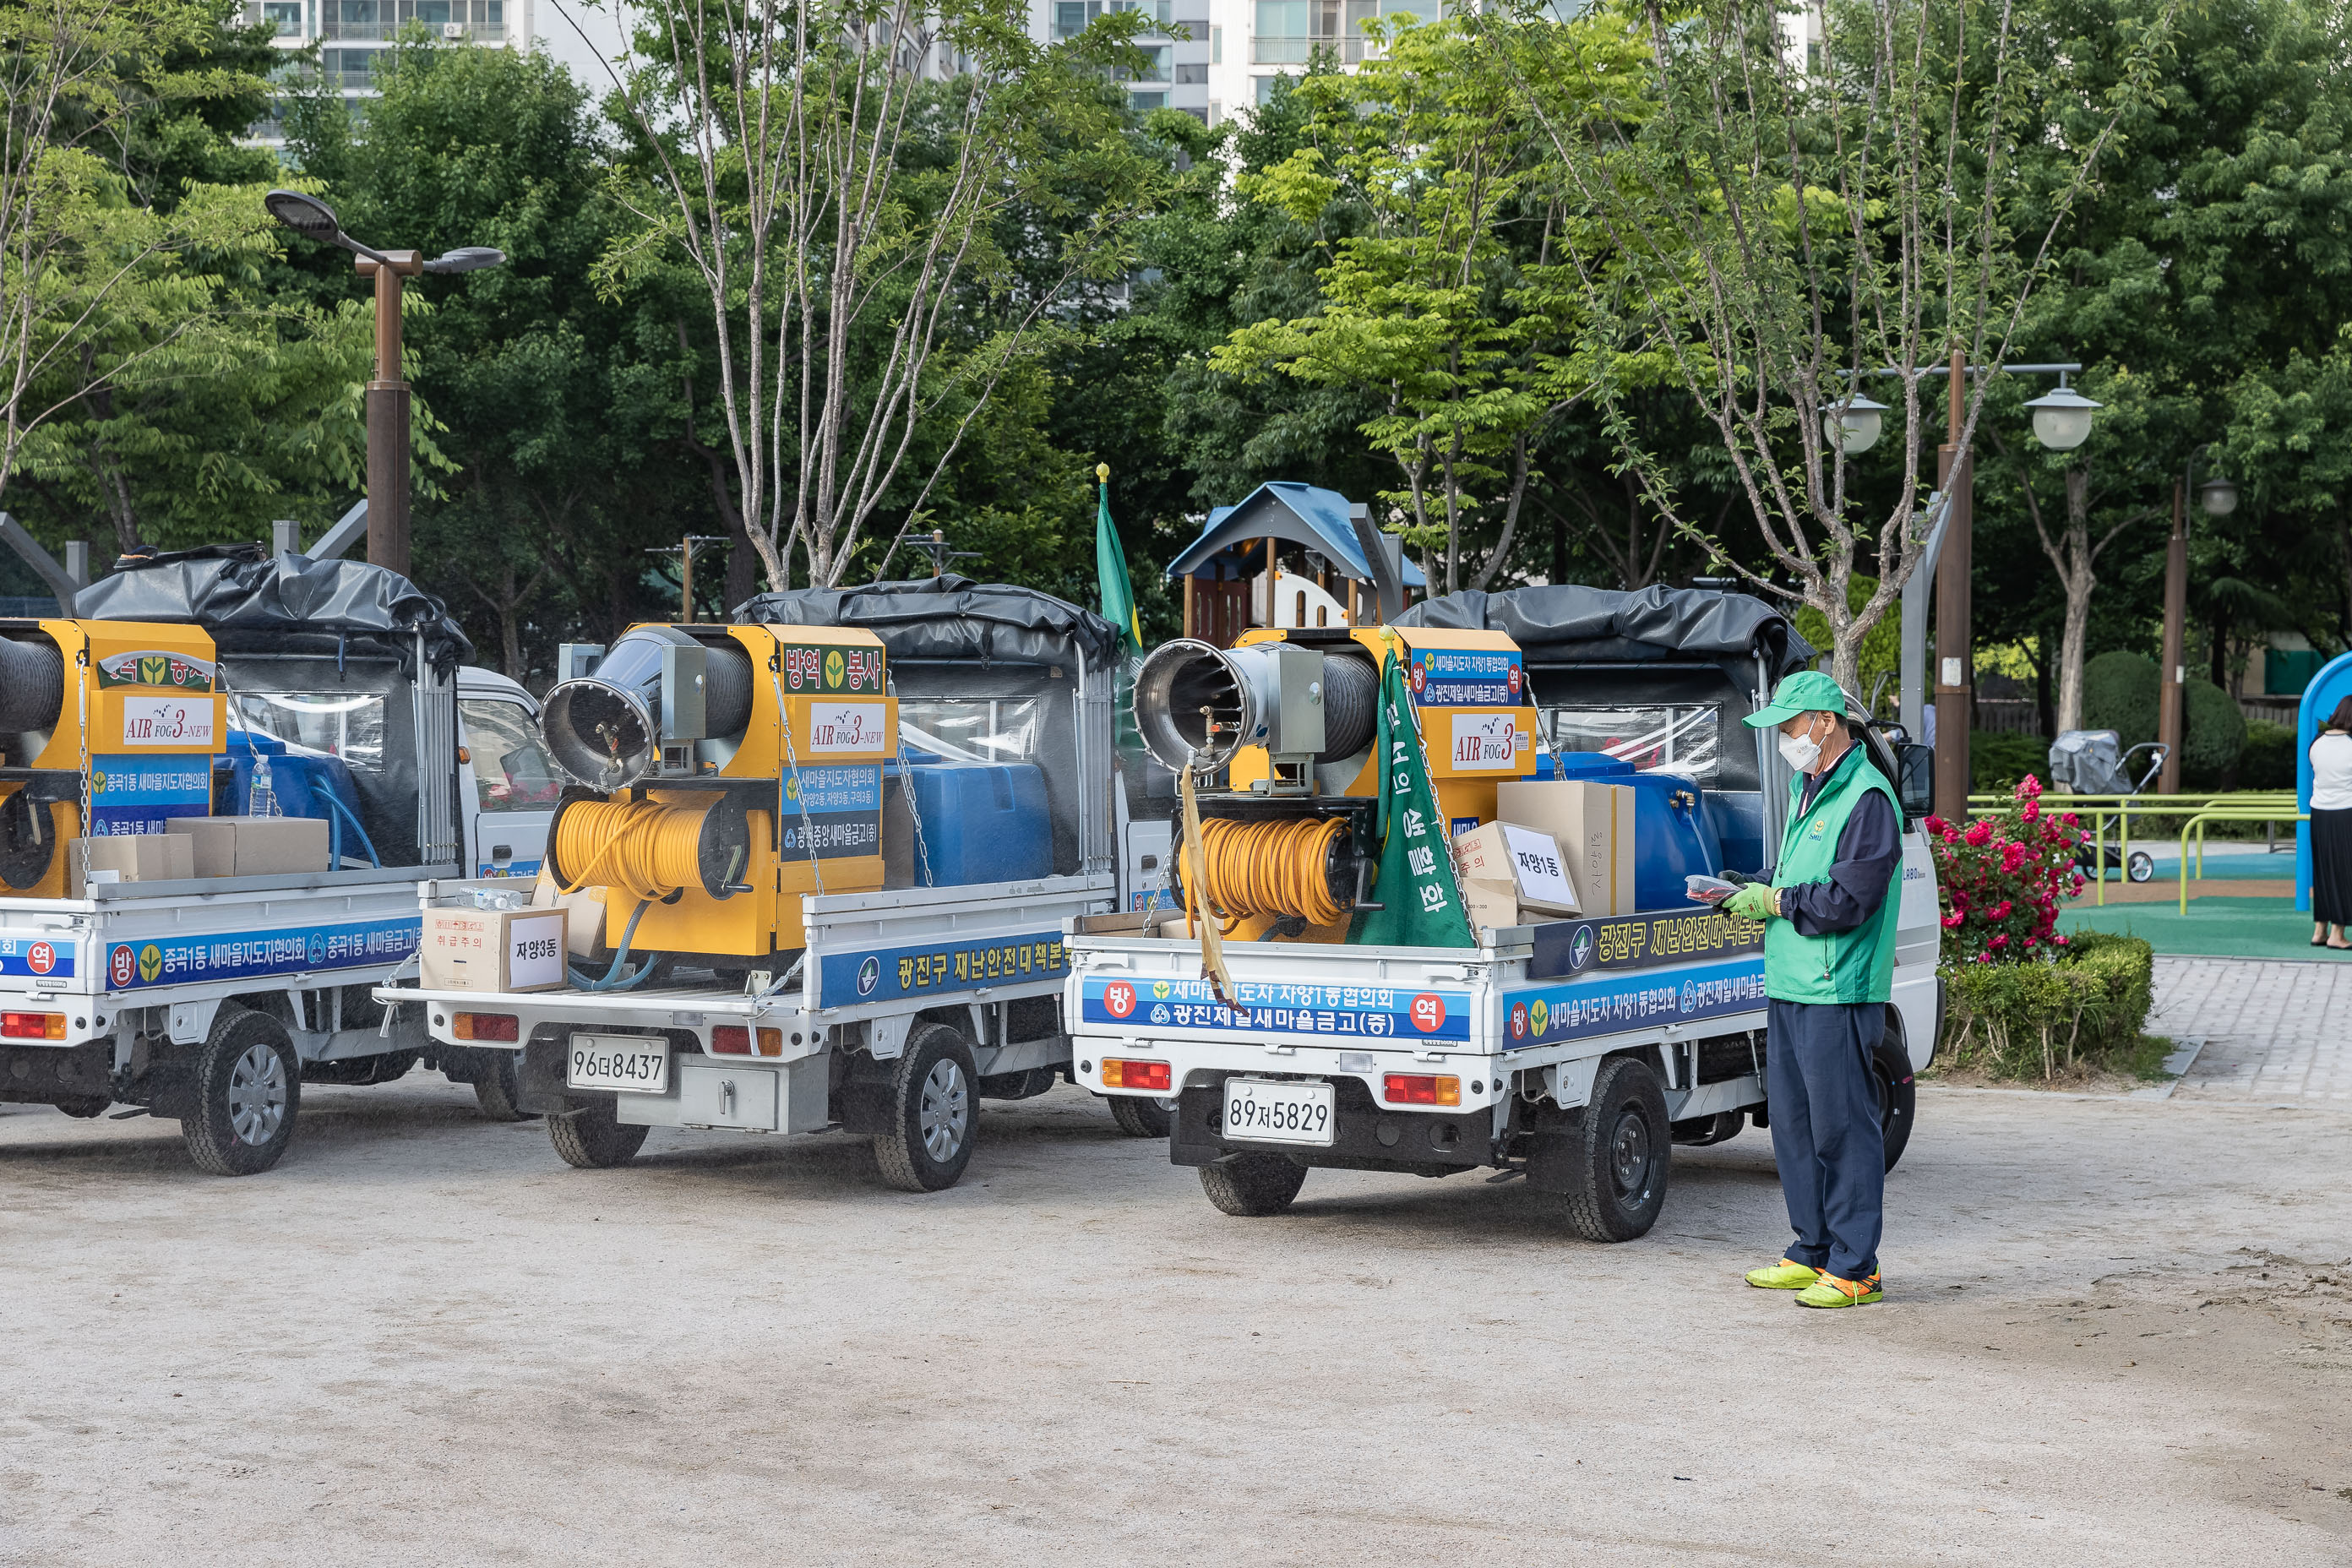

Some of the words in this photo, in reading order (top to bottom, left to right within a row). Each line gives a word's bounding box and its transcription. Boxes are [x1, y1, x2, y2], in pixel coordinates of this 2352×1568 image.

[786, 648, 821, 689] 방역
[847, 650, 881, 690] 봉사
[1435, 655, 1471, 672] 새마을지도자
[1413, 667, 1425, 691] 방
[1510, 669, 1520, 691] 역
[125, 718, 153, 738] AIR
[154, 725, 172, 738] FOG
[811, 725, 835, 745] AIR
[836, 731, 852, 744] FOG
[1454, 736, 1482, 762] AIR
[1483, 743, 1501, 760] FOG
[106, 773, 138, 792] 중곡1동
[139, 772, 208, 792] 새마을지도자협의회
[802, 767, 876, 790] 새마을지도자협의회
[1402, 808, 1448, 913] 생활화
[1516, 851, 1560, 878] 자양1동
[164, 945, 207, 973] 중곡1동
[209, 935, 306, 969] 새마을지도자협의회
[327, 933, 364, 960] 중곡1동
[515, 938, 558, 961] 자양3동
[1598, 922, 1647, 962] 광진구
[32, 945, 50, 970] 역
[115, 951, 133, 982] 방
[898, 952, 948, 991] 광진구
[1108, 987, 1130, 1014] 방
[1416, 1000, 1438, 1028] 역
[1549, 996, 1610, 1030] 새마을지도자
[1513, 1008, 1525, 1037] 방
[574, 1050, 663, 1081] 96더8437
[1230, 1097, 1329, 1133] 89저5829
